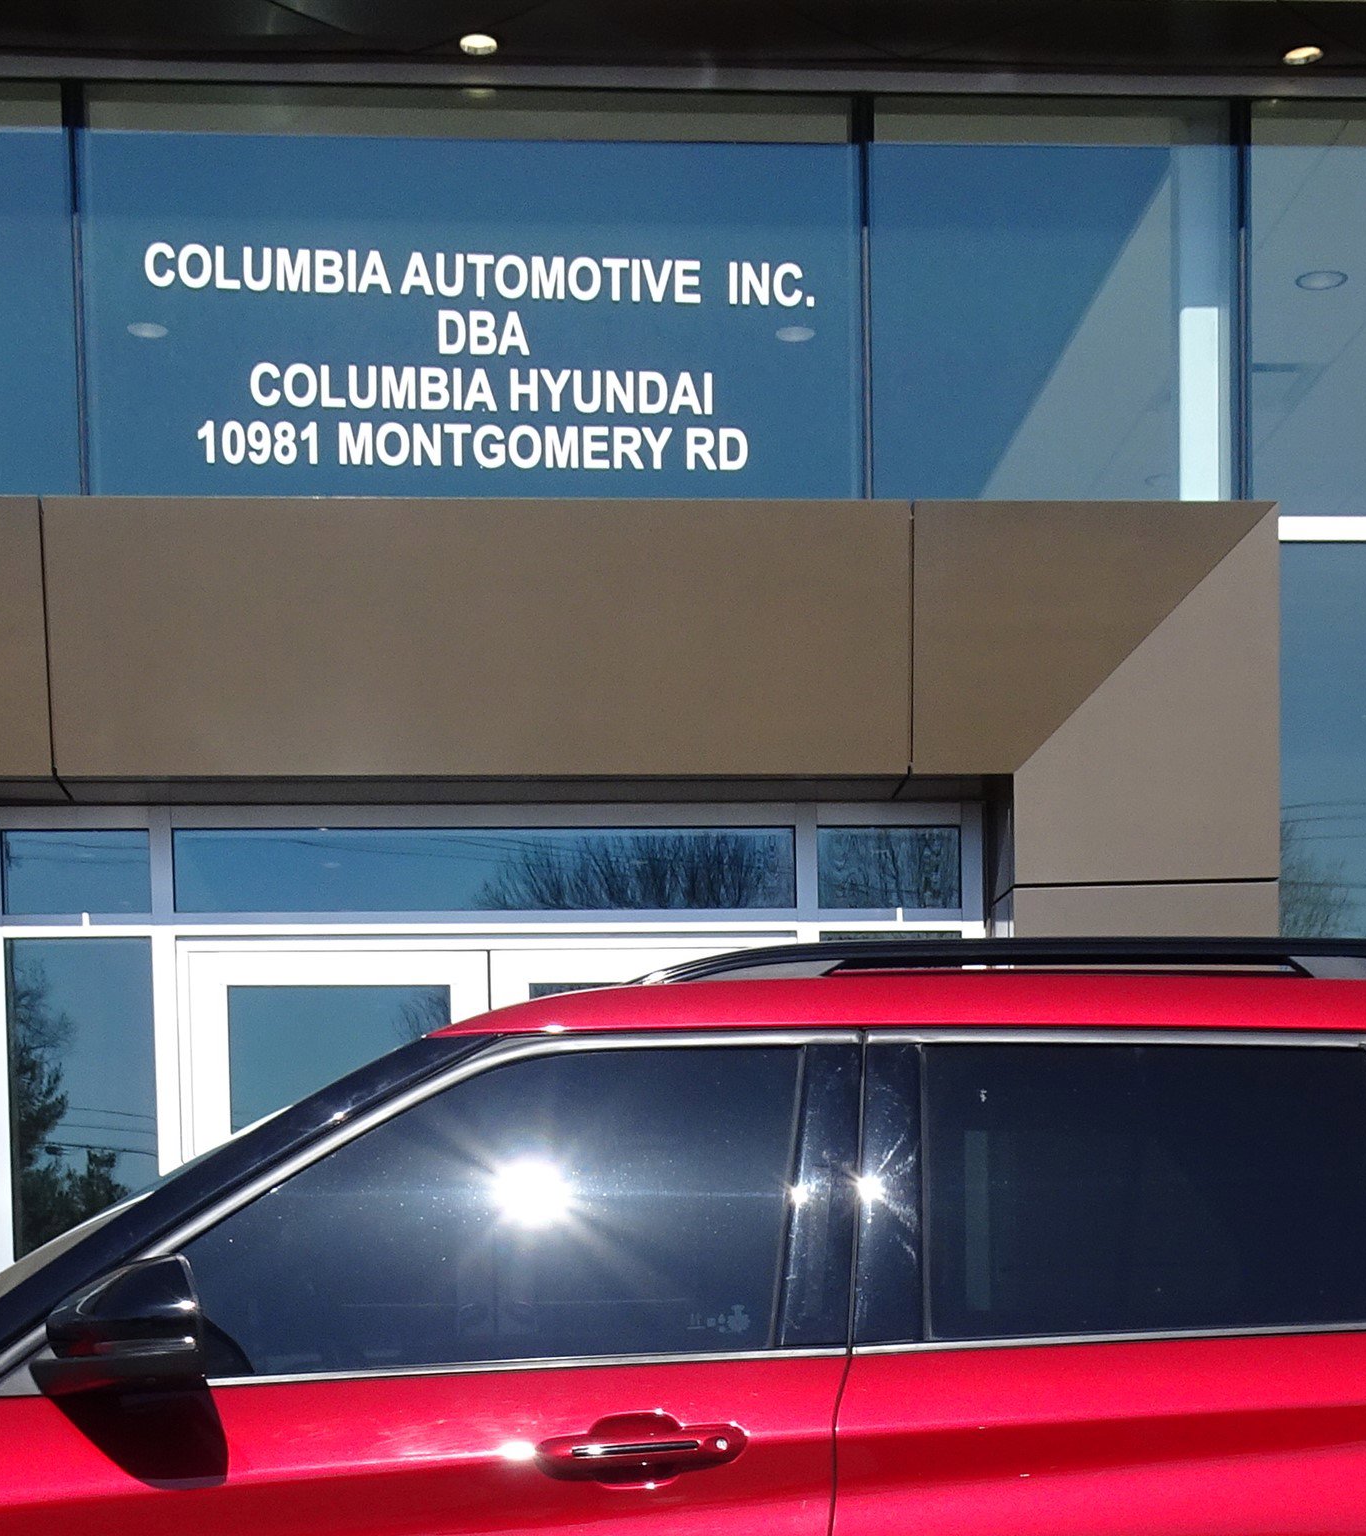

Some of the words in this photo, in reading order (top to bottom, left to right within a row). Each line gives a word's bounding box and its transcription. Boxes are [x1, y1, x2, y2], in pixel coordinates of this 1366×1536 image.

[143, 241, 393, 295] COLUMBIA
[399, 250, 702, 305] AUTOMOTIVE
[728, 260, 816, 308] INC.
[437, 308, 531, 357] DBA
[249, 361, 499, 413] COLUMBIA
[508, 367, 714, 416] HYUNDAI
[196, 419, 319, 466] 10981
[337, 420, 674, 471] MONTGOMERY
[685, 426, 749, 472] RD
